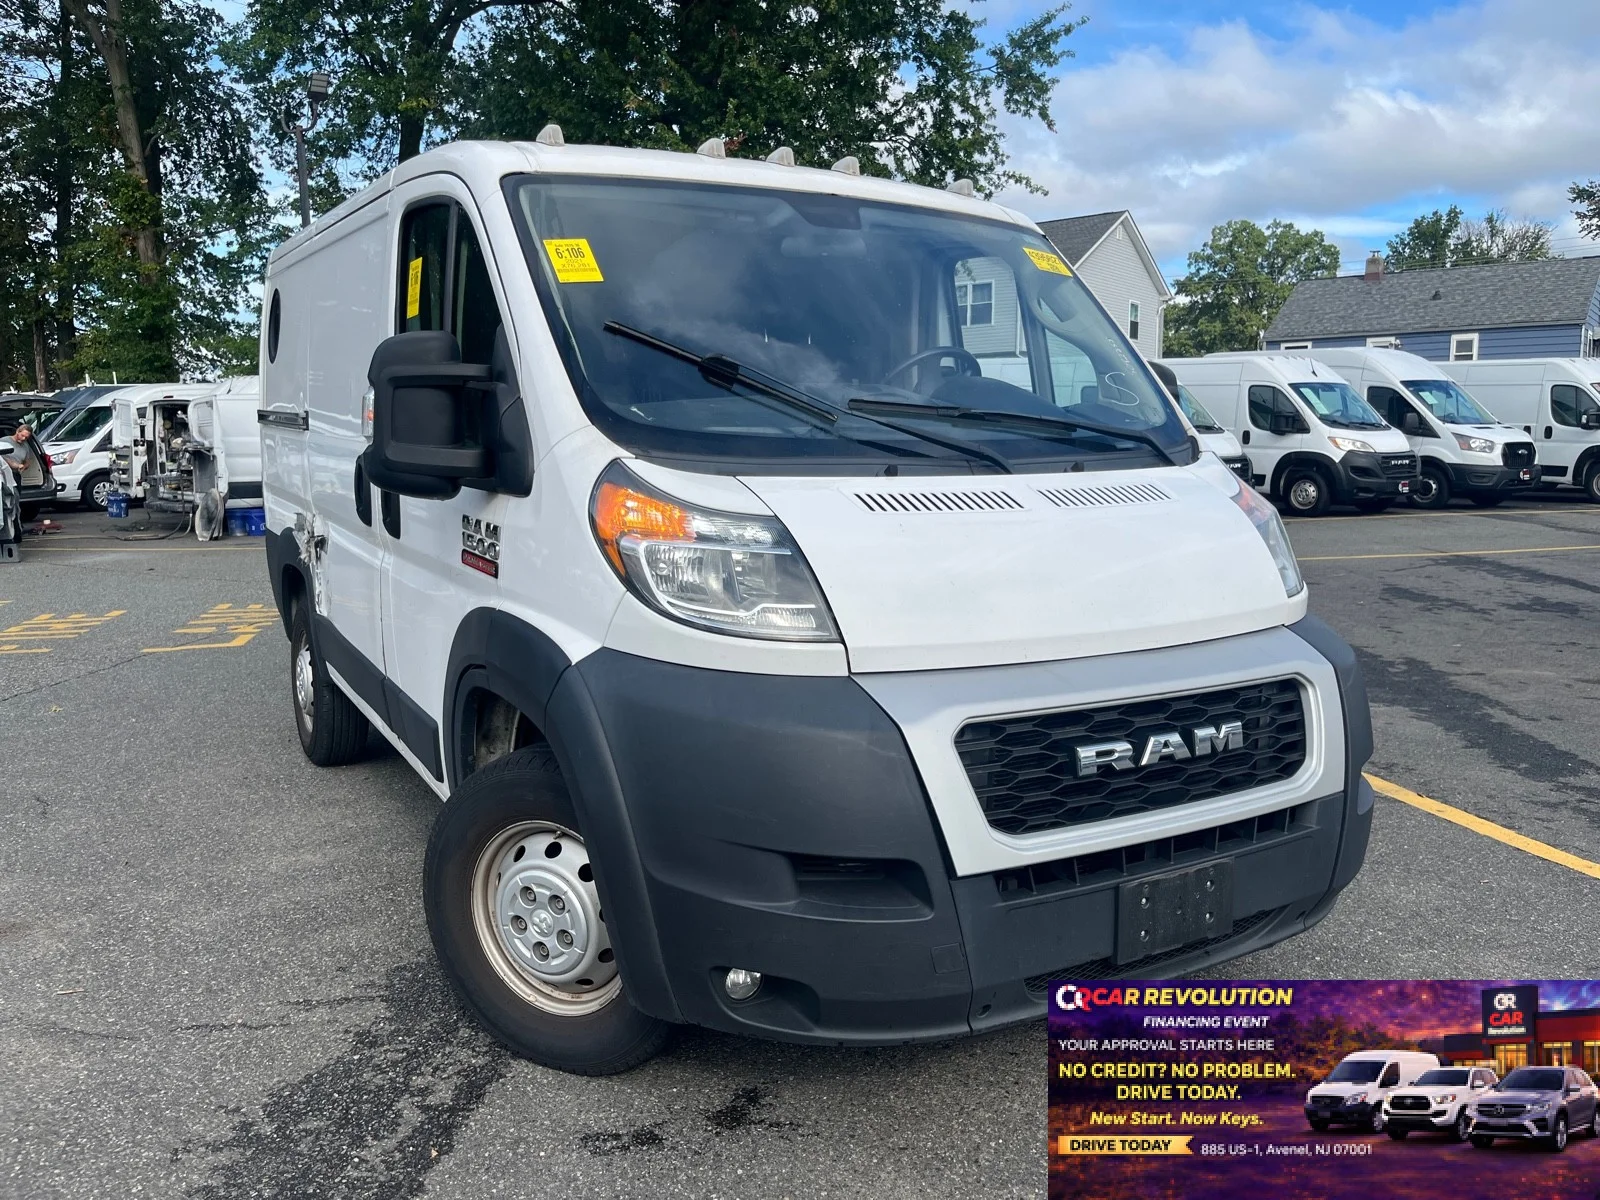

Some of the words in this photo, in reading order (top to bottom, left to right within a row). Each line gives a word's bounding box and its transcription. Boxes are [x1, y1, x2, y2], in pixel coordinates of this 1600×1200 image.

[555, 247, 586, 259] 6:106
[461, 513, 502, 543] RAM
[1076, 721, 1244, 777] RAM
